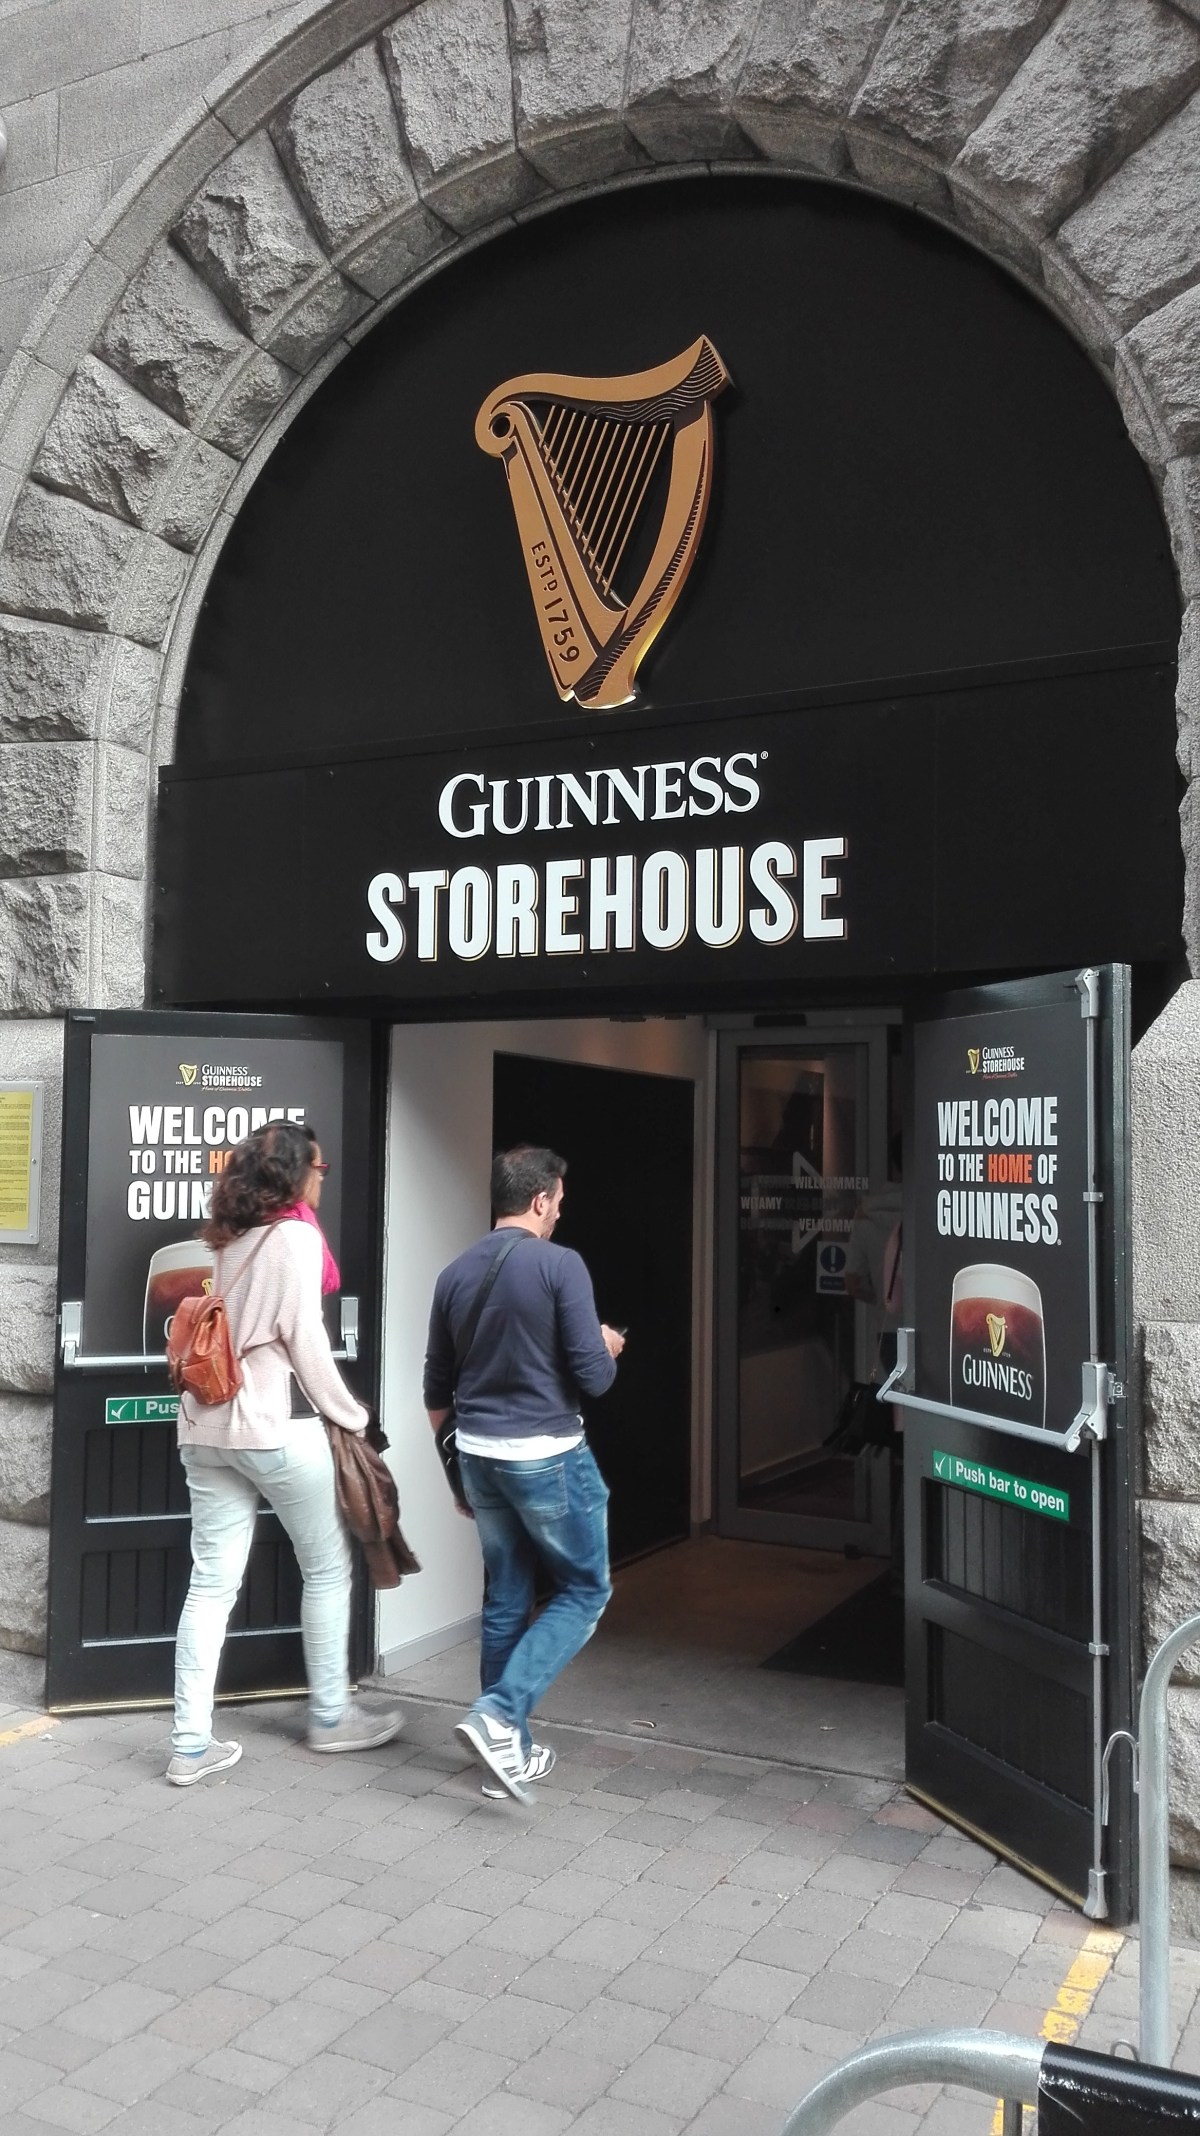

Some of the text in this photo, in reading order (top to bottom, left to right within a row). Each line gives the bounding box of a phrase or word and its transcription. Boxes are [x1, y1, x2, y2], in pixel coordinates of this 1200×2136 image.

[544, 597, 580, 663] 1759
[366, 837, 848, 963] STOREHOUSE
[982, 1046, 1015, 1060] GUINNESS
[202, 1064, 248, 1076] GUINNESS
[982, 1057, 1025, 1073] STOREHOUSE
[202, 1075, 262, 1087] STOREHOUSE
[937, 1096, 1058, 1147] WELCOME
[129, 1150, 156, 1174] TO
[162, 1150, 202, 1174] THE
[937, 1153, 1058, 1185] TO THE HOME OF
[794, 1176, 869, 1190] WILLKOMMEN
[127, 1180, 215, 1220] GUIN
[740, 1196, 783, 1210] WITAMY
[798, 1218, 854, 1232] VELKOMM
[962, 1353, 1033, 1400] GUINNESS
[145, 1400, 180, 1415] Pus
[955, 1460, 1065, 1513] Push bar to open
